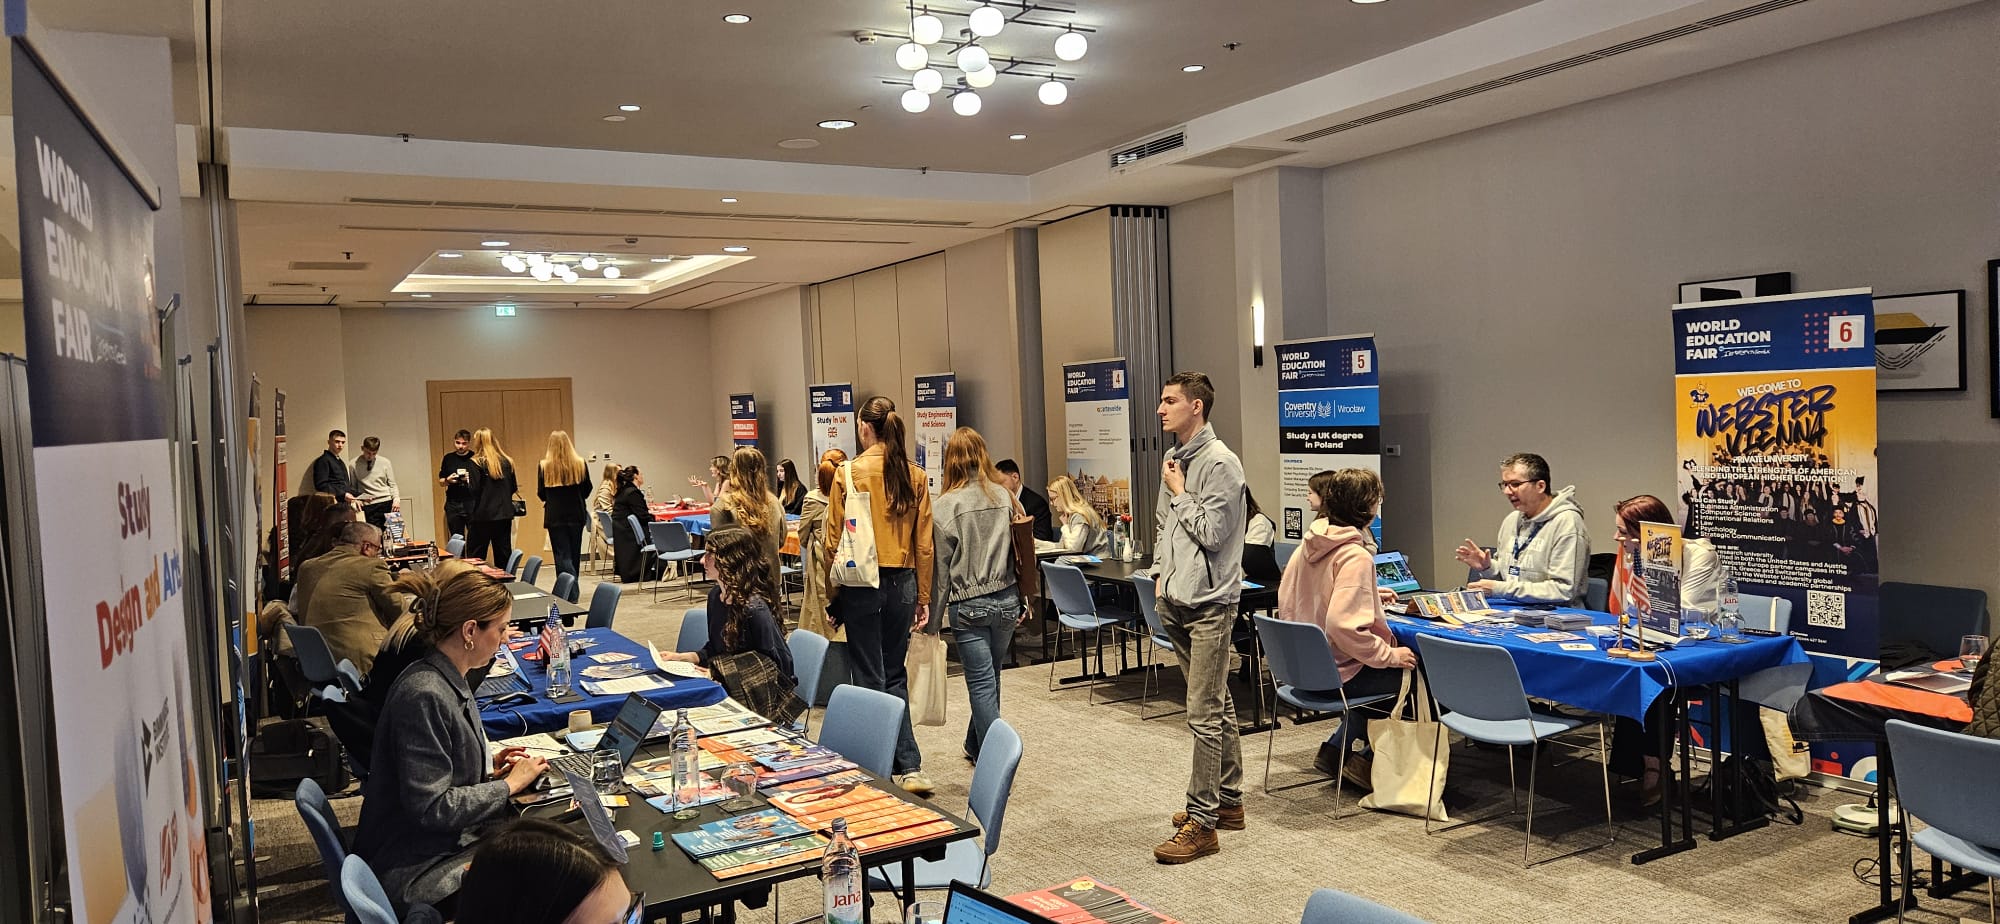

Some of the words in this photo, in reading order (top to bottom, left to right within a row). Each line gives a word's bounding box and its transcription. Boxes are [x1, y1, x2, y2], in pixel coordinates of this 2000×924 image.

[35, 135, 93, 232] WORLD
[52, 297, 94, 363] FAIR
[1686, 319, 1741, 333] WORLD
[1840, 322, 1852, 342] 6
[1686, 330, 1771, 347] EDUCATION
[1282, 352, 1310, 360] WORLD
[1686, 348, 1718, 360] FAIR
[1282, 360, 1326, 370] EDUCATION
[1357, 354, 1364, 368] 5
[1067, 371, 1086, 379] WORLD
[1116, 374, 1120, 384] 4
[1282, 372, 1298, 380] FAIR
[1067, 378, 1096, 386] EDUCATION
[1737, 381, 1786, 397] WELCOME
[1787, 378, 1801, 388] TO
[1284, 402, 1317, 411] Coventry
[1696, 385, 1836, 438] WEBSTER
[1284, 410, 1317, 419] University
[816, 416, 831, 425] Study
[1332, 432, 1363, 440] degree
[1726, 410, 1828, 457] VIENNA
[1733, 456, 1764, 464] PRIVATE
[1764, 454, 1809, 463] UNIVERSITY
[118, 475, 151, 540] Study
[1700, 525, 1737, 534] Psychology
[1700, 530, 1730, 539] Strategic
[1732, 532, 1786, 542] Communication
[1775, 569, 1812, 577] Switzerland
[1795, 565, 1827, 573] campuses
[1781, 574, 1812, 583] University
[1810, 583, 1852, 592] partnerships
[96, 574, 143, 670] Design
[144, 554, 161, 621] and
